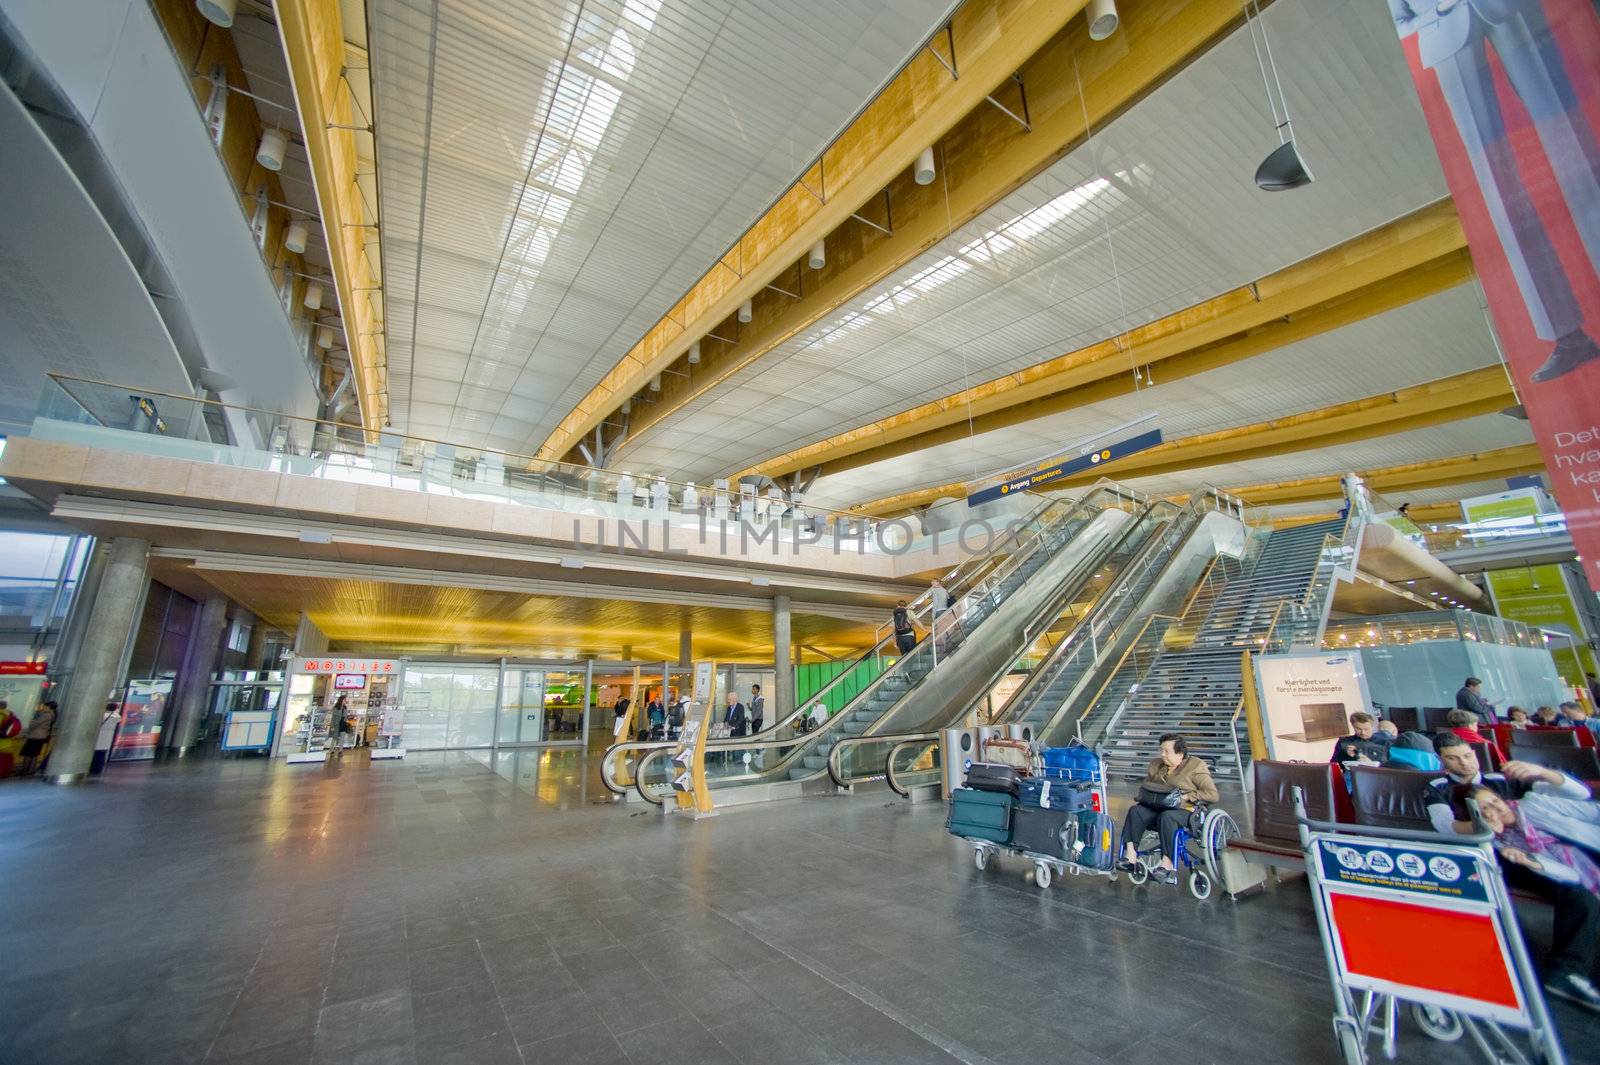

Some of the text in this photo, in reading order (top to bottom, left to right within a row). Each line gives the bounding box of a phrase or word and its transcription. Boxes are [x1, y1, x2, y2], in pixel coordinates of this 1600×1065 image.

[1556, 426, 1600, 447] Det
[1010, 469, 1062, 490] Avgang Departures
[305, 661, 392, 671] MOBILES
